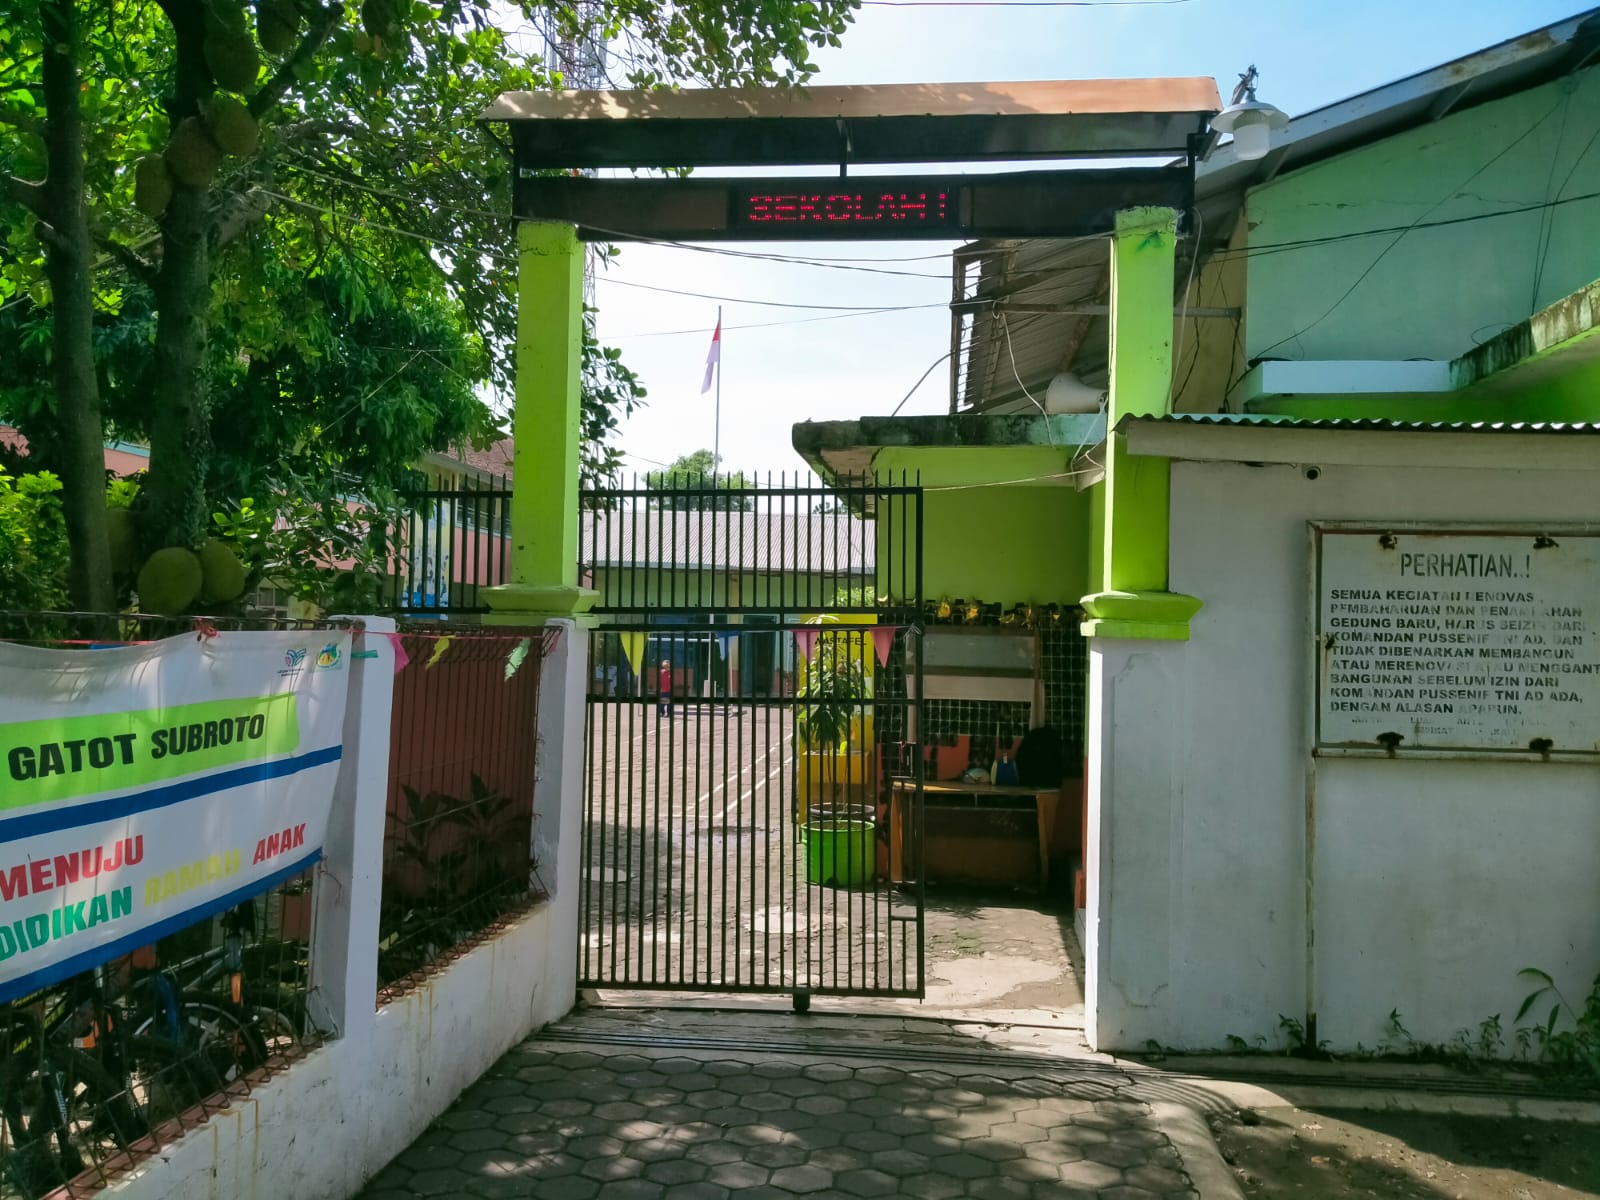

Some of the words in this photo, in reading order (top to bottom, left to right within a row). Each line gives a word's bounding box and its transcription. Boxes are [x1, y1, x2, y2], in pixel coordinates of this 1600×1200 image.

[749, 193, 926, 220] SEKOLAH
[1331, 590, 1381, 600] SEMUA
[1386, 590, 1461, 601] KEGIATAN
[1330, 603, 1440, 615] PEMBAHARUAN
[1446, 604, 1476, 616] DAN
[1330, 617, 1391, 628] GEDUNG
[1396, 618, 1440, 631] BARU,
[1332, 630, 1414, 642] KOMANDAN
[1419, 632, 1489, 644] PUSSENIF
[1495, 634, 1518, 645] NI
[1553, 635, 1582, 646] DAN
[1331, 645, 1375, 656] TIDAK
[1379, 646, 1474, 658] DIBENARKAN
[1480, 648, 1574, 659] MEMBANGUN
[1331, 660, 1370, 670] ATAU
[1330, 673, 1412, 685] BANGUNAN
[1418, 674, 1486, 686] SEBELUM
[1490, 676, 1520, 687] IZIN
[1525, 676, 1559, 687] DARI
[1330, 687, 1414, 699] KOMNDAN
[1420, 688, 1489, 700] PUSSENIF
[1495, 690, 1519, 701] TNI
[1524, 690, 1544, 701] AD
[1550, 691, 1583, 704] ADA,
[1331, 701, 1391, 712] DENGAN
[1396, 702, 1454, 713] ALASAN
[8, 733, 137, 781] GATOT
[151, 713, 265, 760] SUBROTO
[0, 835, 144, 902] MENUJU
[144, 849, 242, 907] RAMAH
[252, 823, 307, 865] ANAK
